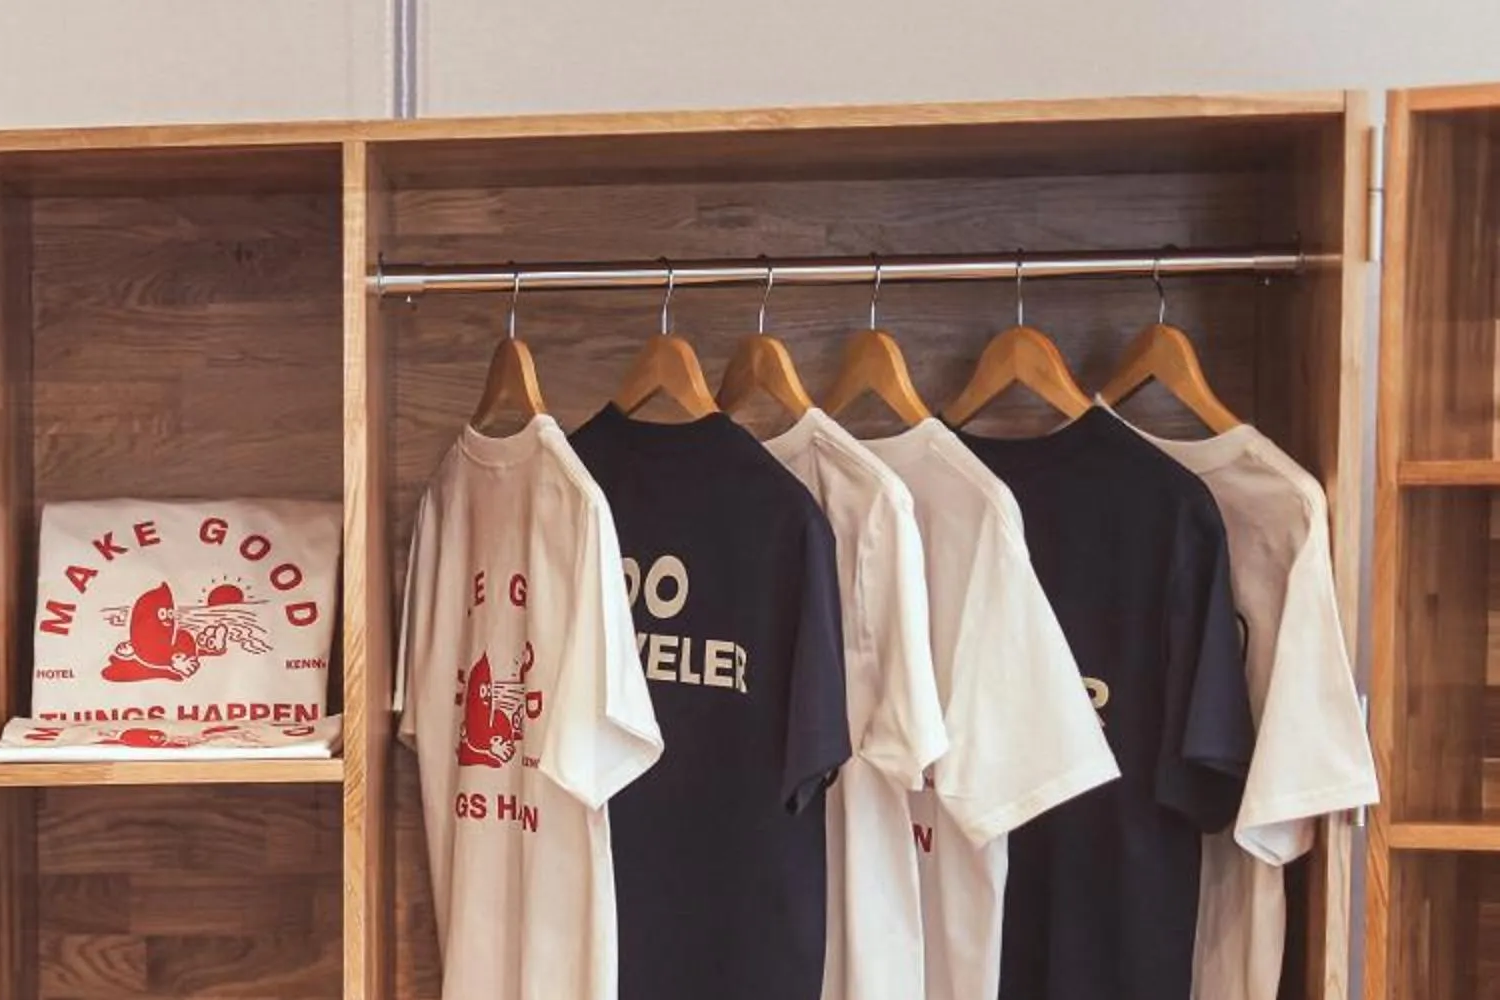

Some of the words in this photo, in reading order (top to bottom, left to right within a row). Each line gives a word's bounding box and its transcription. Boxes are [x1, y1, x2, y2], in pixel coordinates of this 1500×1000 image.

[39, 521, 161, 636] MAKE
[198, 517, 318, 627] GOOD
[36, 668, 76, 680] HOTEL
